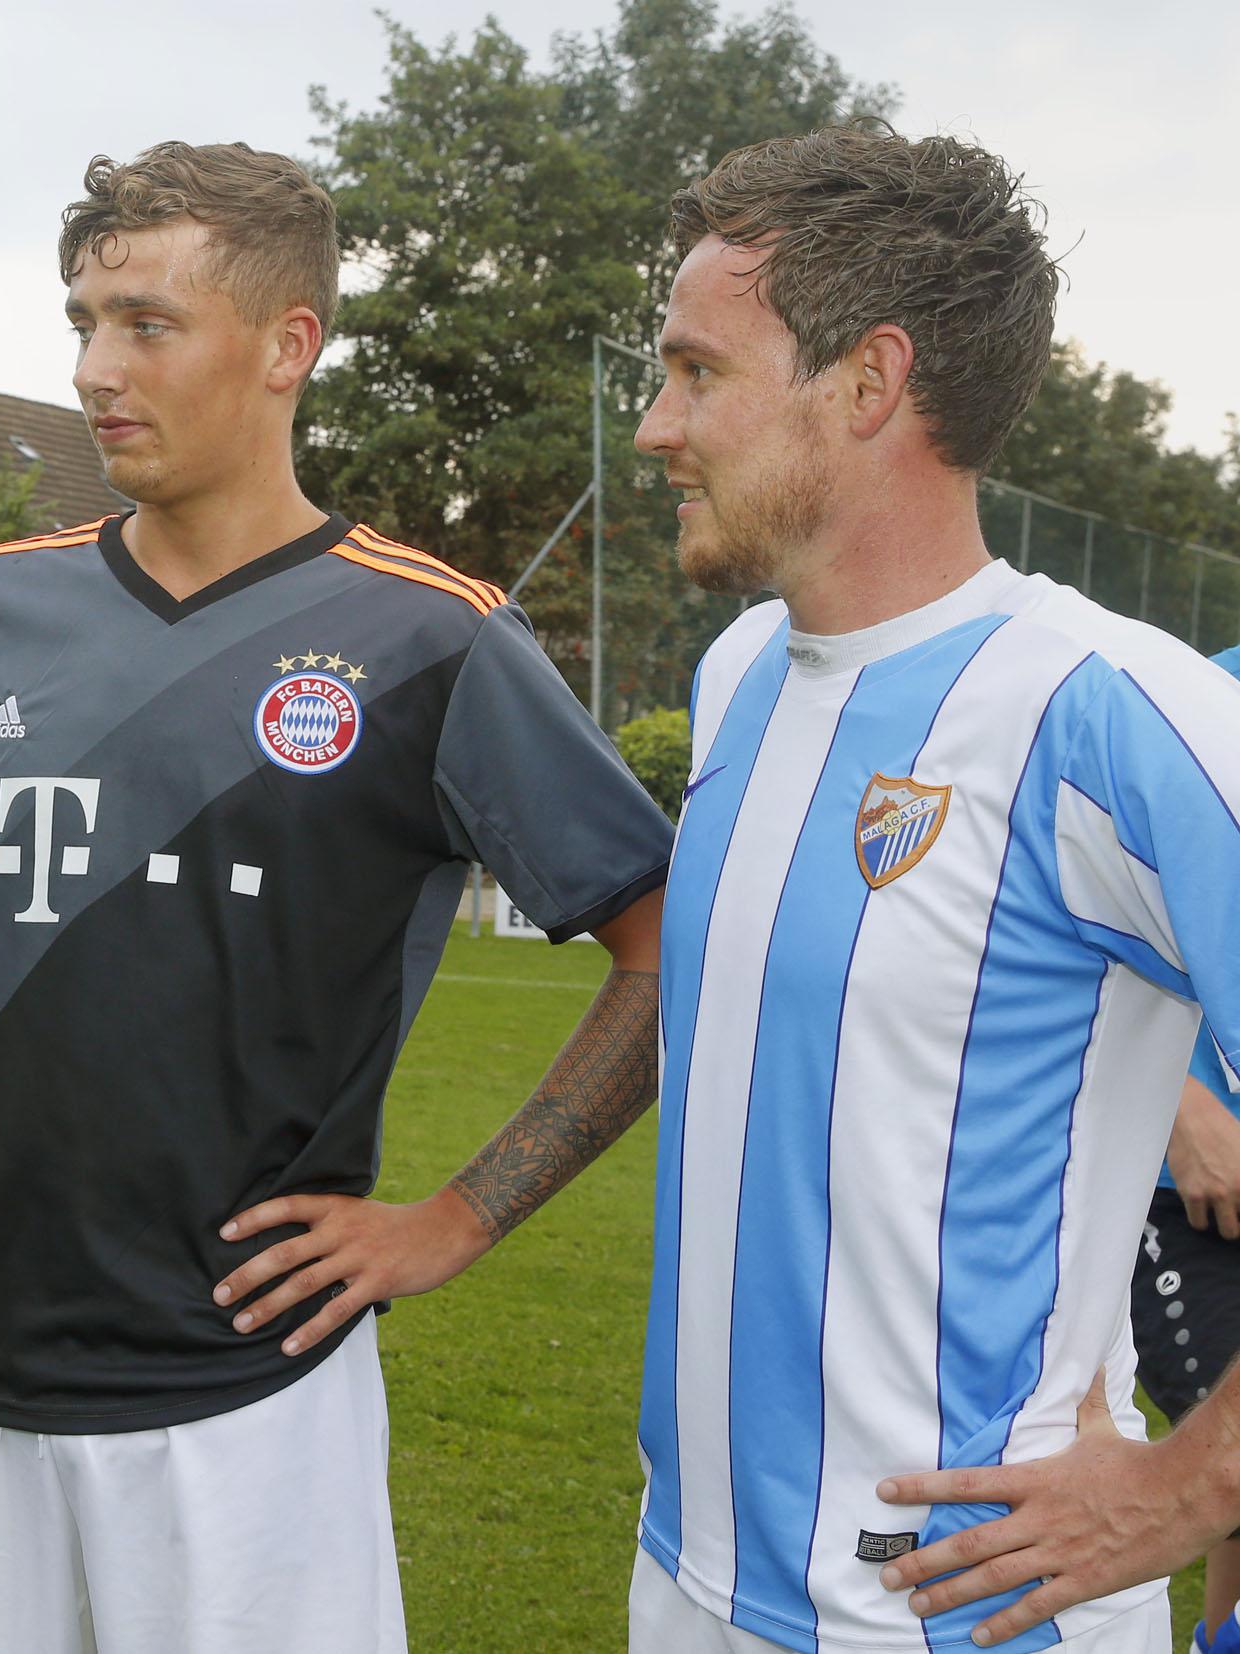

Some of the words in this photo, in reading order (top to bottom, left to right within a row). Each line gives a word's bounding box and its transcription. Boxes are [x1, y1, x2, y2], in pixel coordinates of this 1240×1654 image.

[276, 685, 297, 702] FC
[300, 681, 353, 723] BAYERN
[265, 720, 339, 762] MÜNCHEN
[910, 798, 931, 815] C.F.
